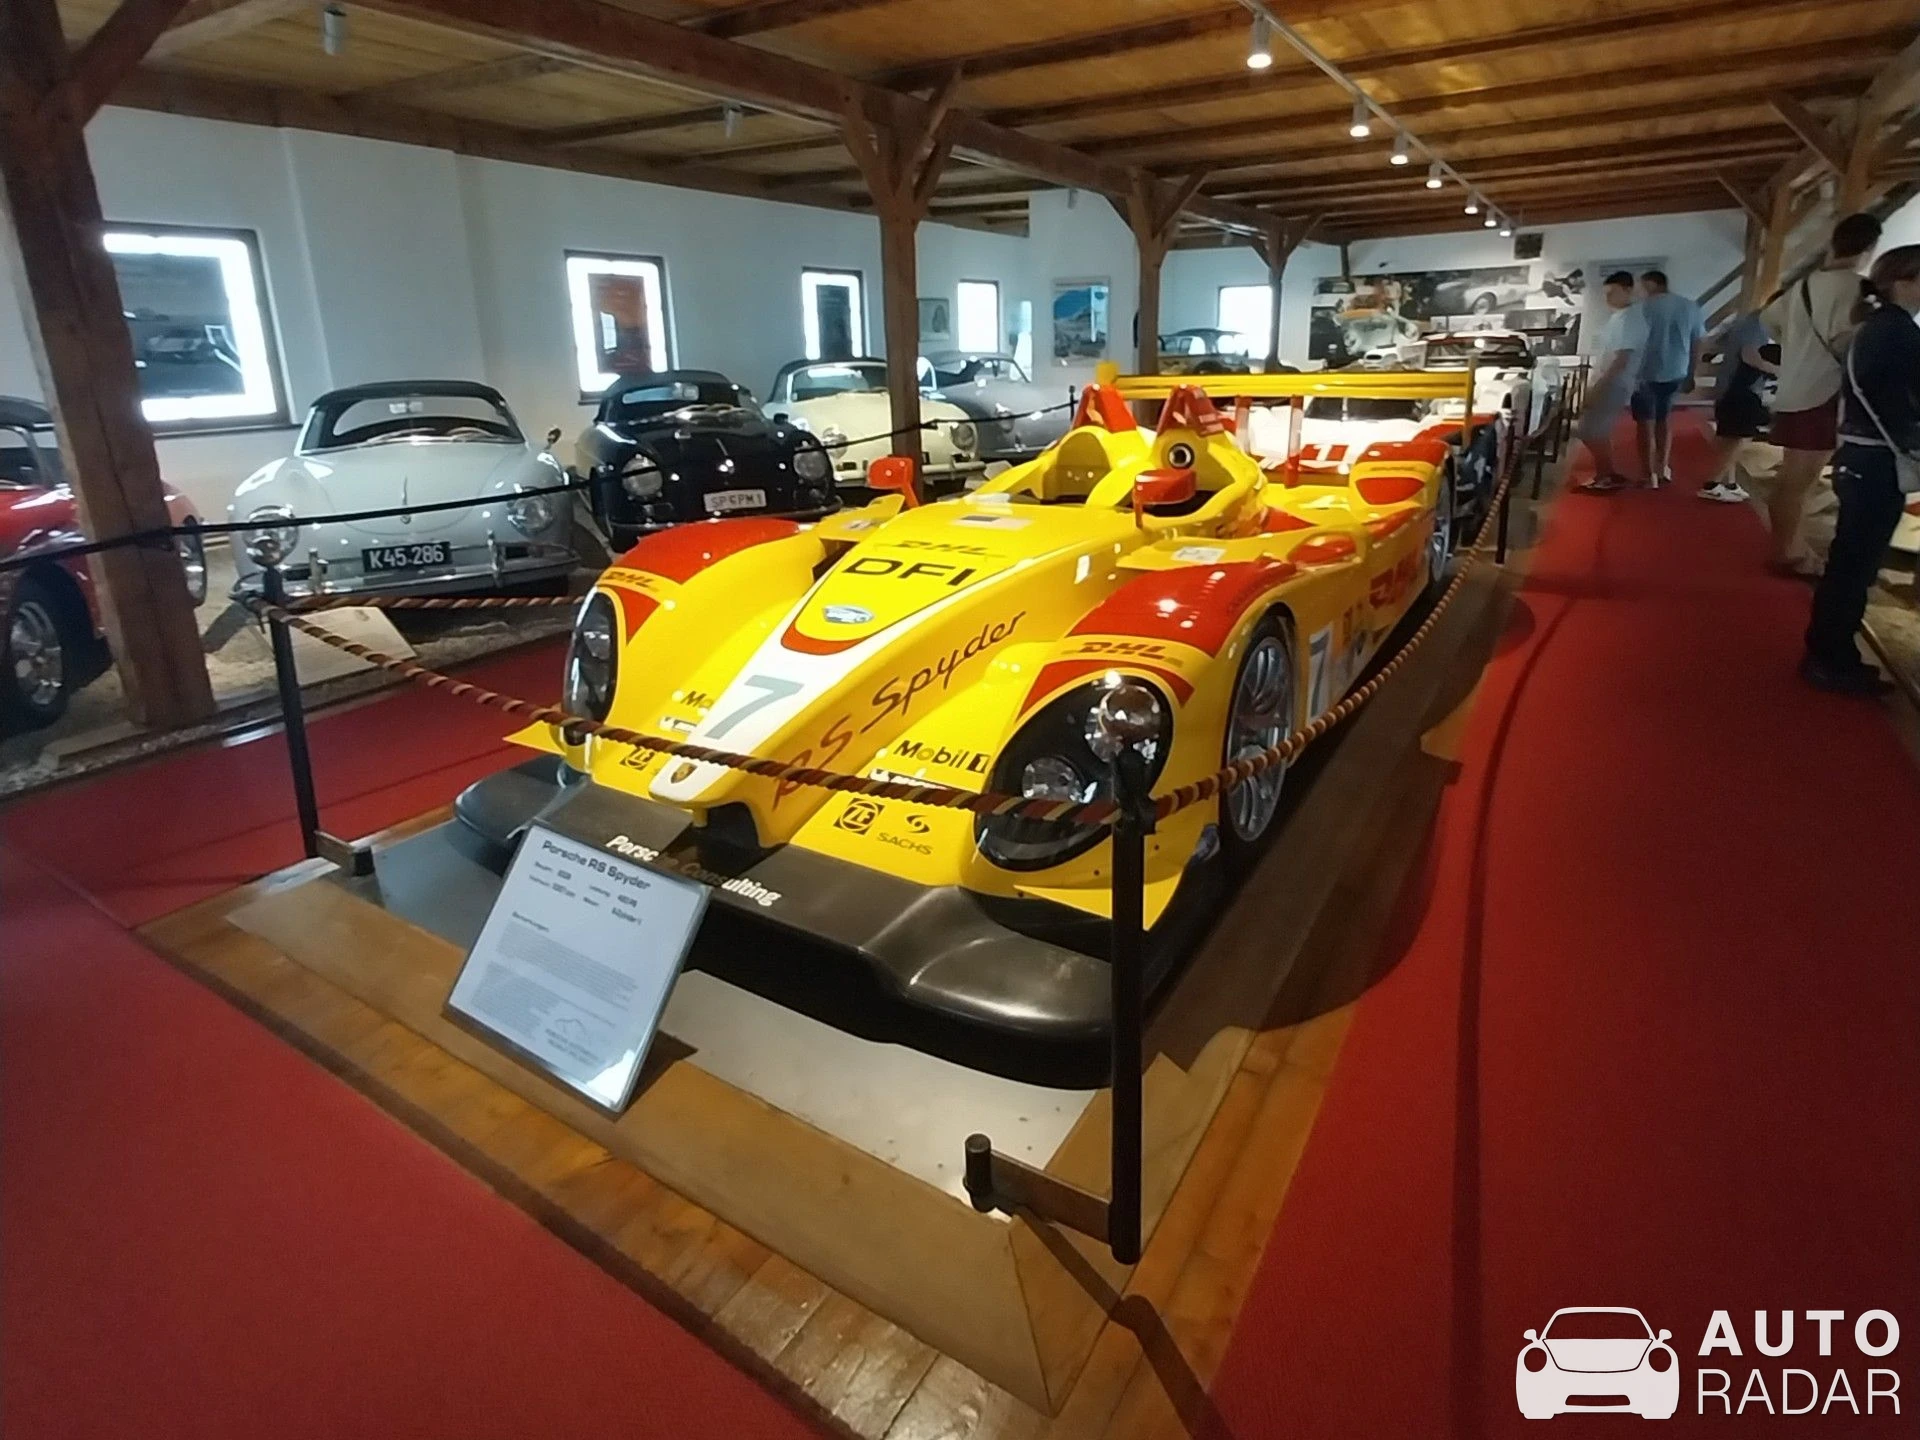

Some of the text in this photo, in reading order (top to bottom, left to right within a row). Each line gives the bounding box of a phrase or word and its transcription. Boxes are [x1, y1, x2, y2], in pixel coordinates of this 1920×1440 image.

[842, 557, 977, 587] DFI
[1080, 642, 1166, 660] DHL
[859, 611, 1026, 734] Spyder
[704, 674, 805, 740] 7
[893, 740, 969, 769] Mobil
[876, 832, 933, 855] SACHS
[542, 840, 587, 866] Porsche
[588, 857, 607, 873] RS
[607, 866, 651, 889] Spyder
